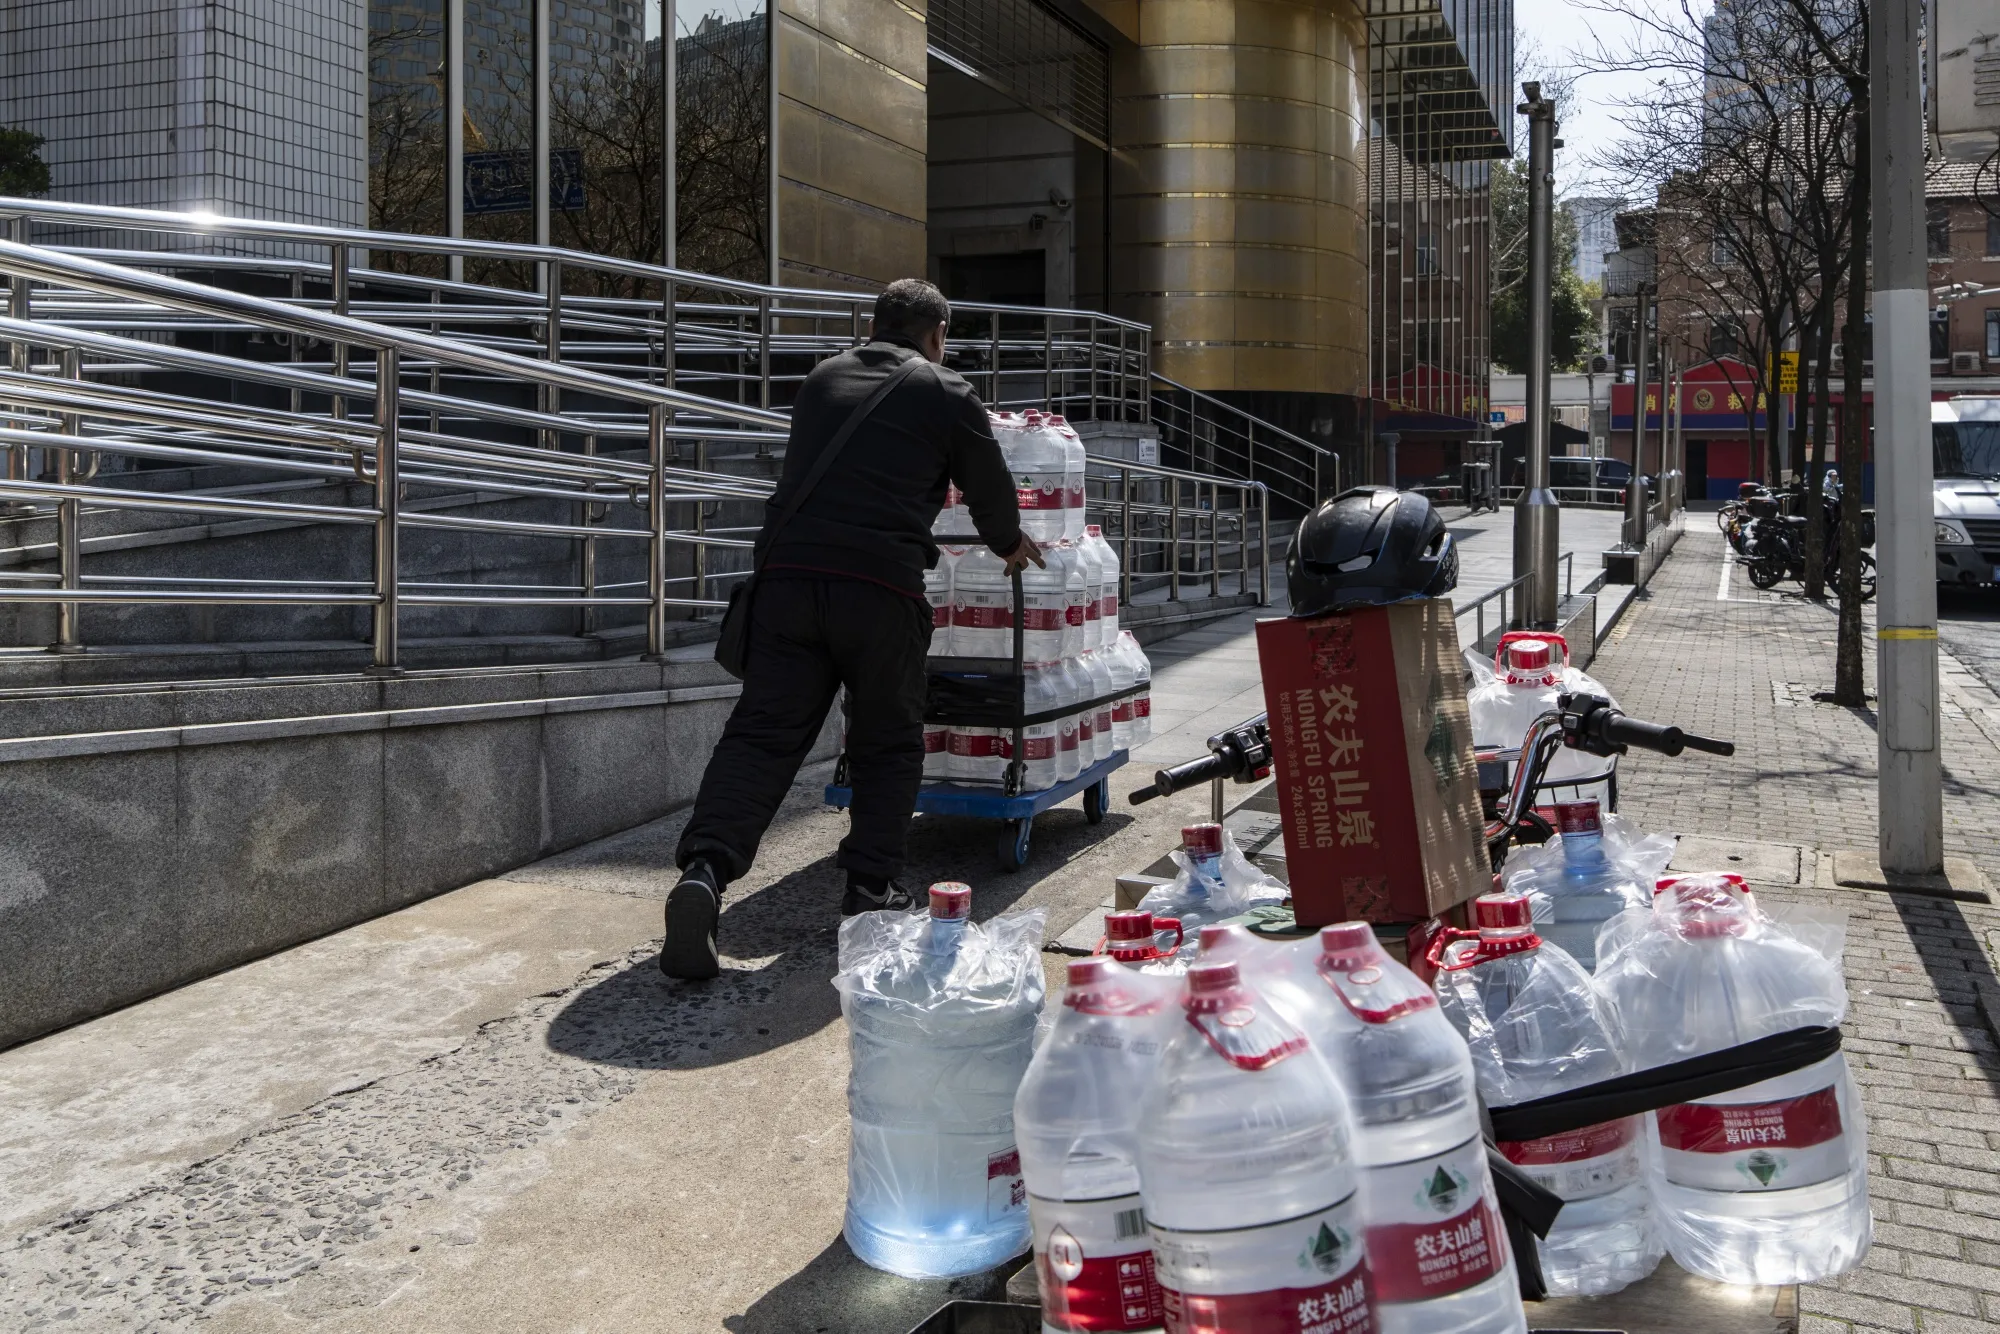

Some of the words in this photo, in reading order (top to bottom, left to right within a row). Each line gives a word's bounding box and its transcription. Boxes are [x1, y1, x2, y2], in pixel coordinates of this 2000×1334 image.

[1295, 688, 1323, 767] NONGFU
[1279, 691, 1296, 747] 饮用天然水
[1290, 785, 1311, 849] 24x380ml
[1319, 683, 1376, 848] 农夫山泉
[1307, 775, 1334, 848] SPRING
[1723, 1118, 1752, 1127] SPRING
[1725, 1125, 1787, 1144] 农夫山泉
[1754, 1115, 1784, 1126] NONGFU
[1053, 1243, 1075, 1266] 5L
[1414, 1217, 1484, 1258] 农夫山泉
[1418, 1253, 1458, 1273] NONGFU
[1459, 1240, 1488, 1262] SPRING
[1298, 1278, 1365, 1326] 农夫山泉
